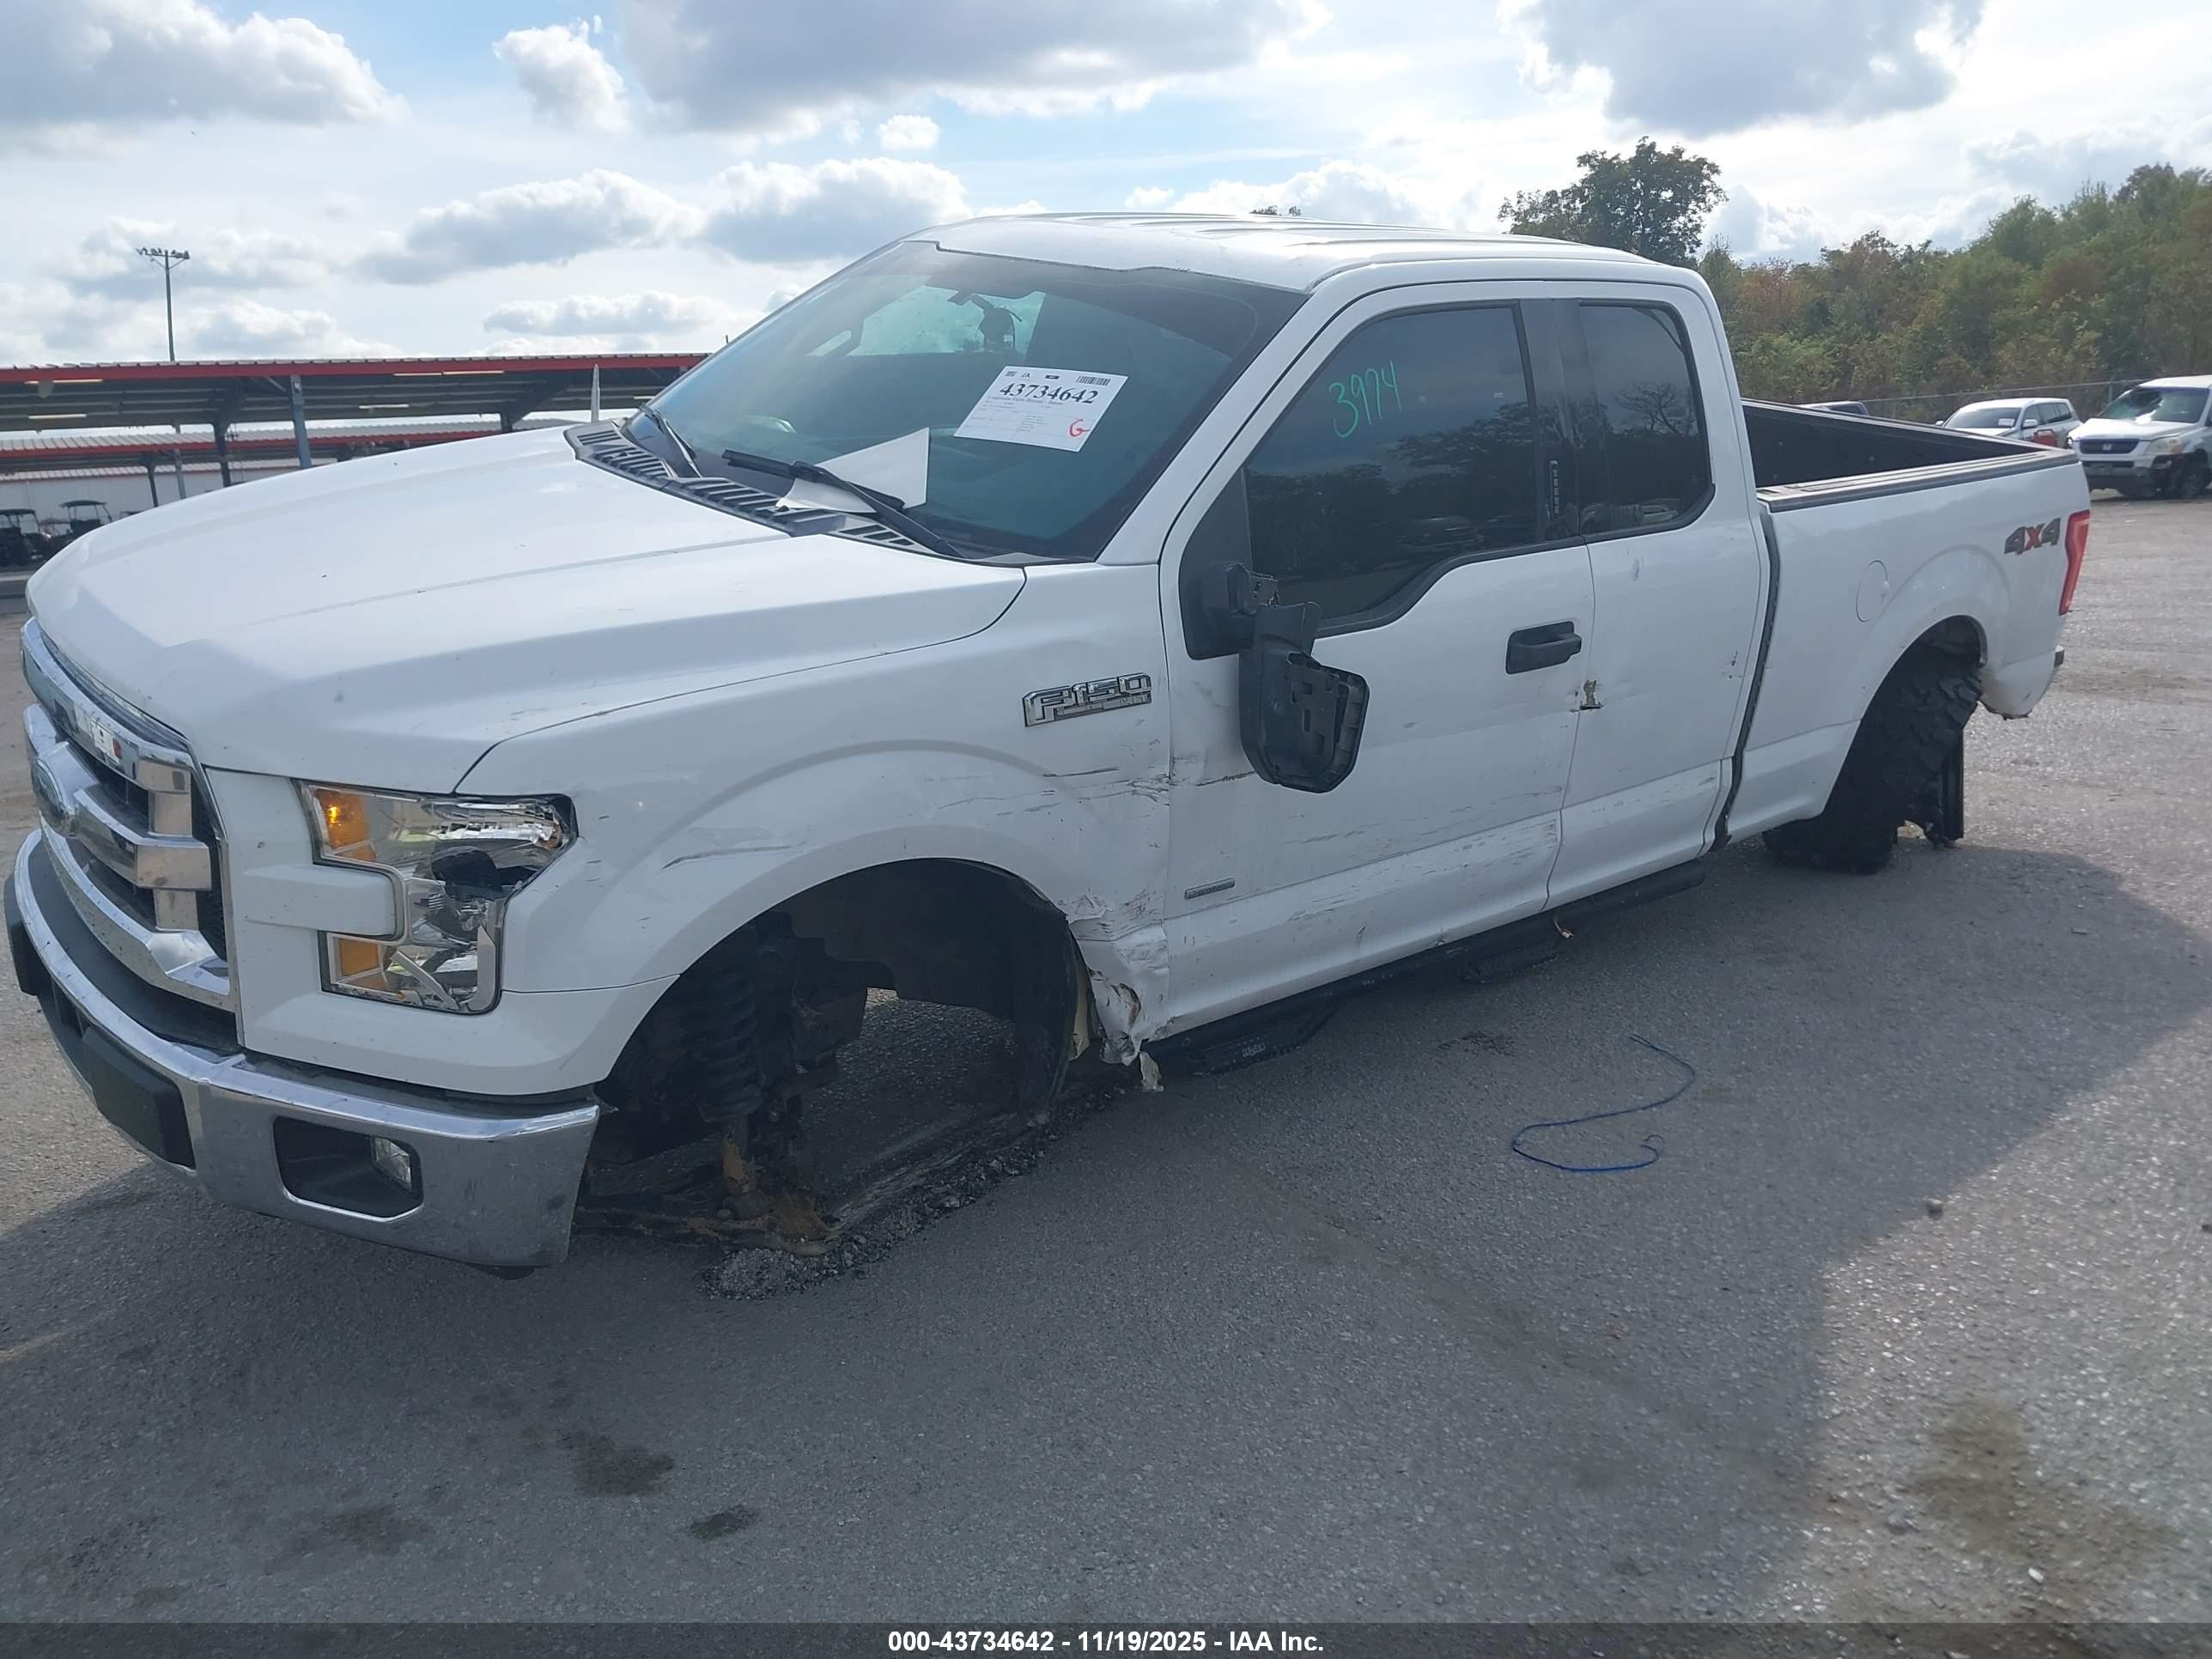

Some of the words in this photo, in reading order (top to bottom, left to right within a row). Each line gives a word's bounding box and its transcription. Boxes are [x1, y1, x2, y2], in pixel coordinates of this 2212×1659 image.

[1000, 382, 1099, 404] 43734642
[1328, 360, 1401, 439] 3974
[1069, 418, 1091, 437] G
